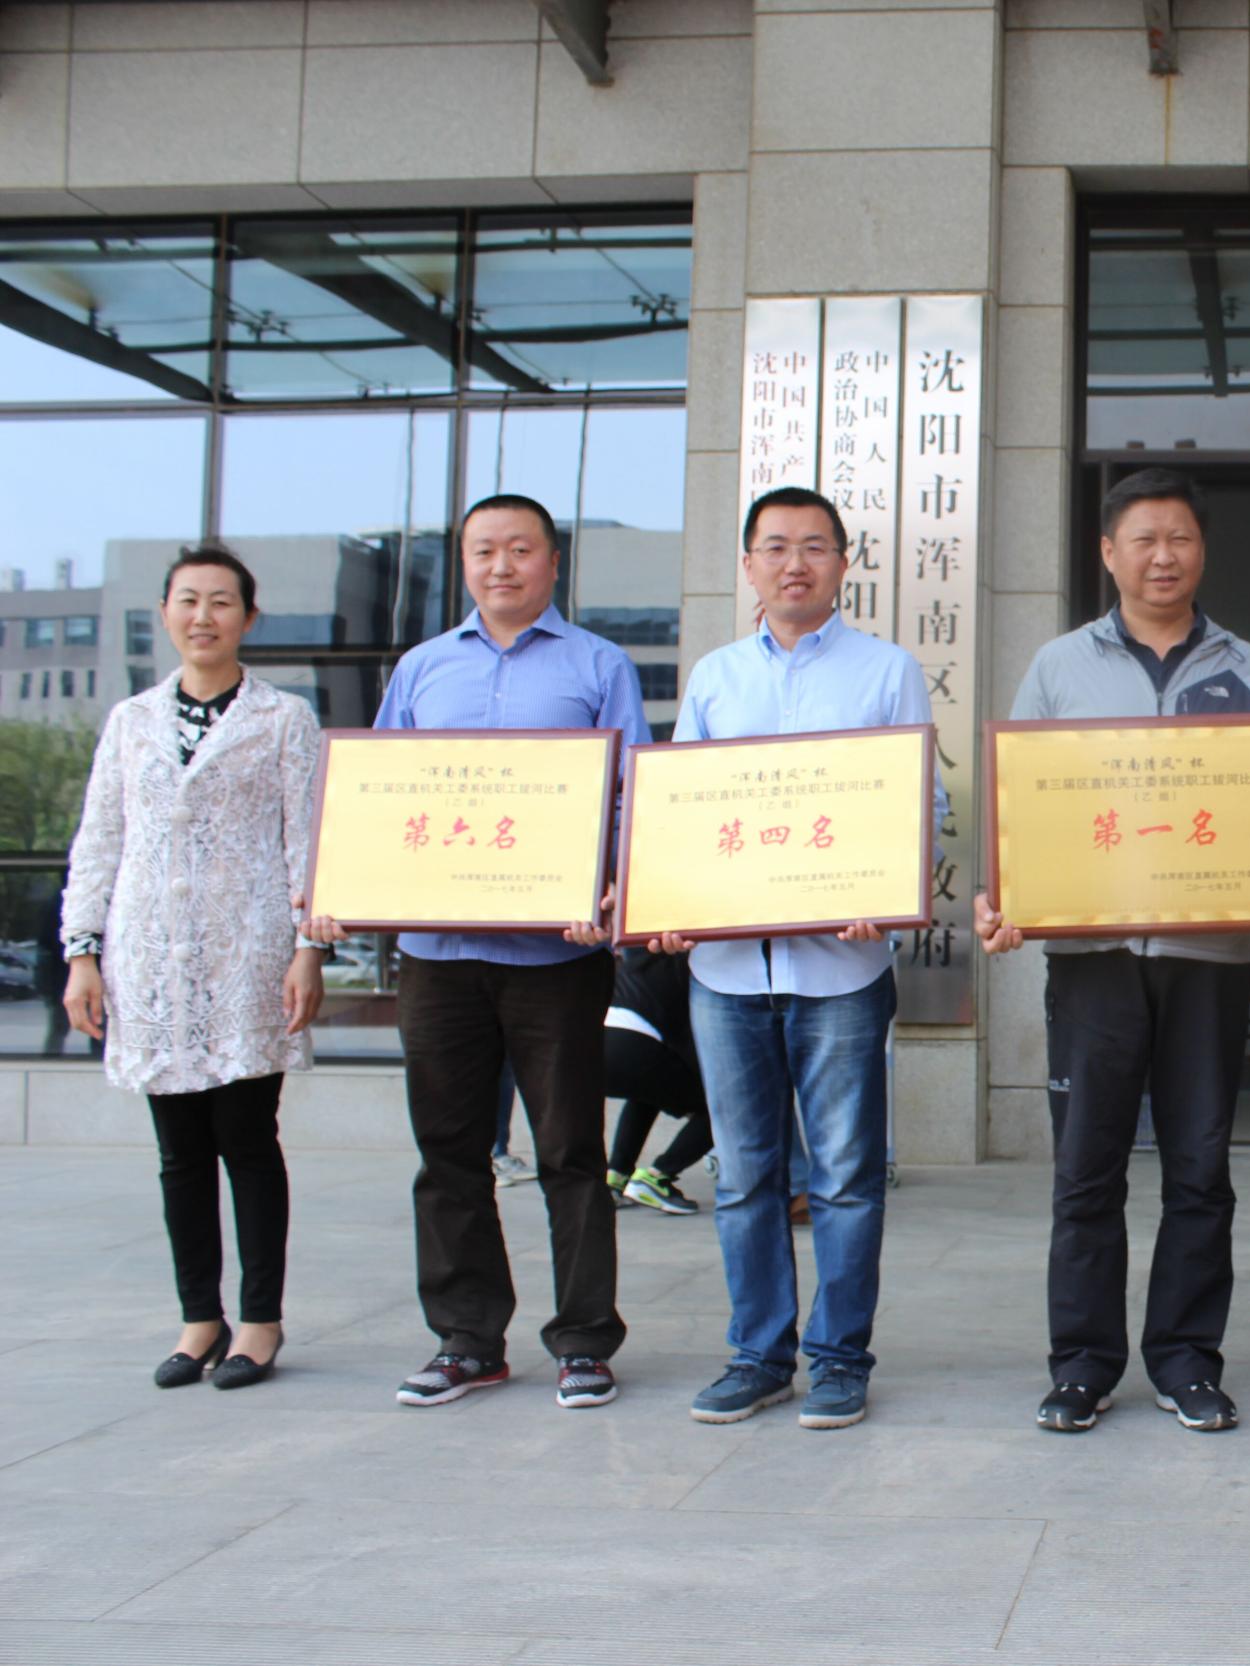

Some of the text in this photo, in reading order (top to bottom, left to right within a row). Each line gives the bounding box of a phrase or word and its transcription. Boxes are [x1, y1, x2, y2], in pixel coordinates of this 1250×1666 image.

[750, 351, 777, 502] 沈阳市浑南
[780, 351, 806, 478] 中国共产
[833, 351, 858, 511] 政治协商会议
[863, 351, 888, 511] 中国人民
[835, 530, 880, 637] 沈阳
[403, 812, 518, 853] 第六名
[716, 814, 836, 859] 第四名
[1092, 808, 1218, 854] 第一名
